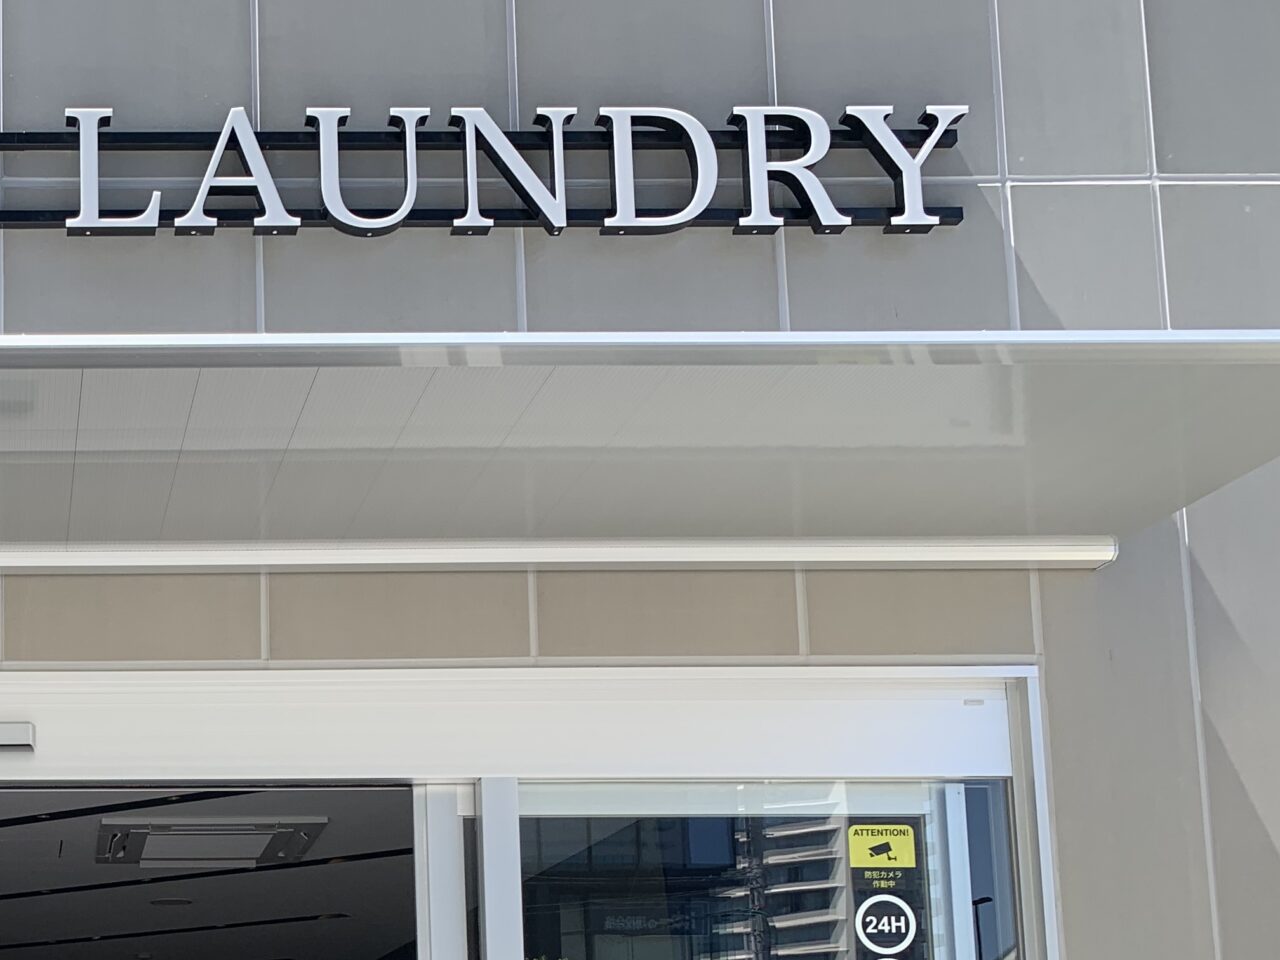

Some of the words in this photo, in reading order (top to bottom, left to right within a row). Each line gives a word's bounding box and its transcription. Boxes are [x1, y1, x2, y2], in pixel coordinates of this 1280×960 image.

[64, 104, 969, 232] LAUNDRY
[853, 828, 910, 837] ATTENTION!
[864, 870, 903, 880] 防犯カメラ
[872, 880, 896, 889] 作動中
[865, 915, 907, 934] 24H
